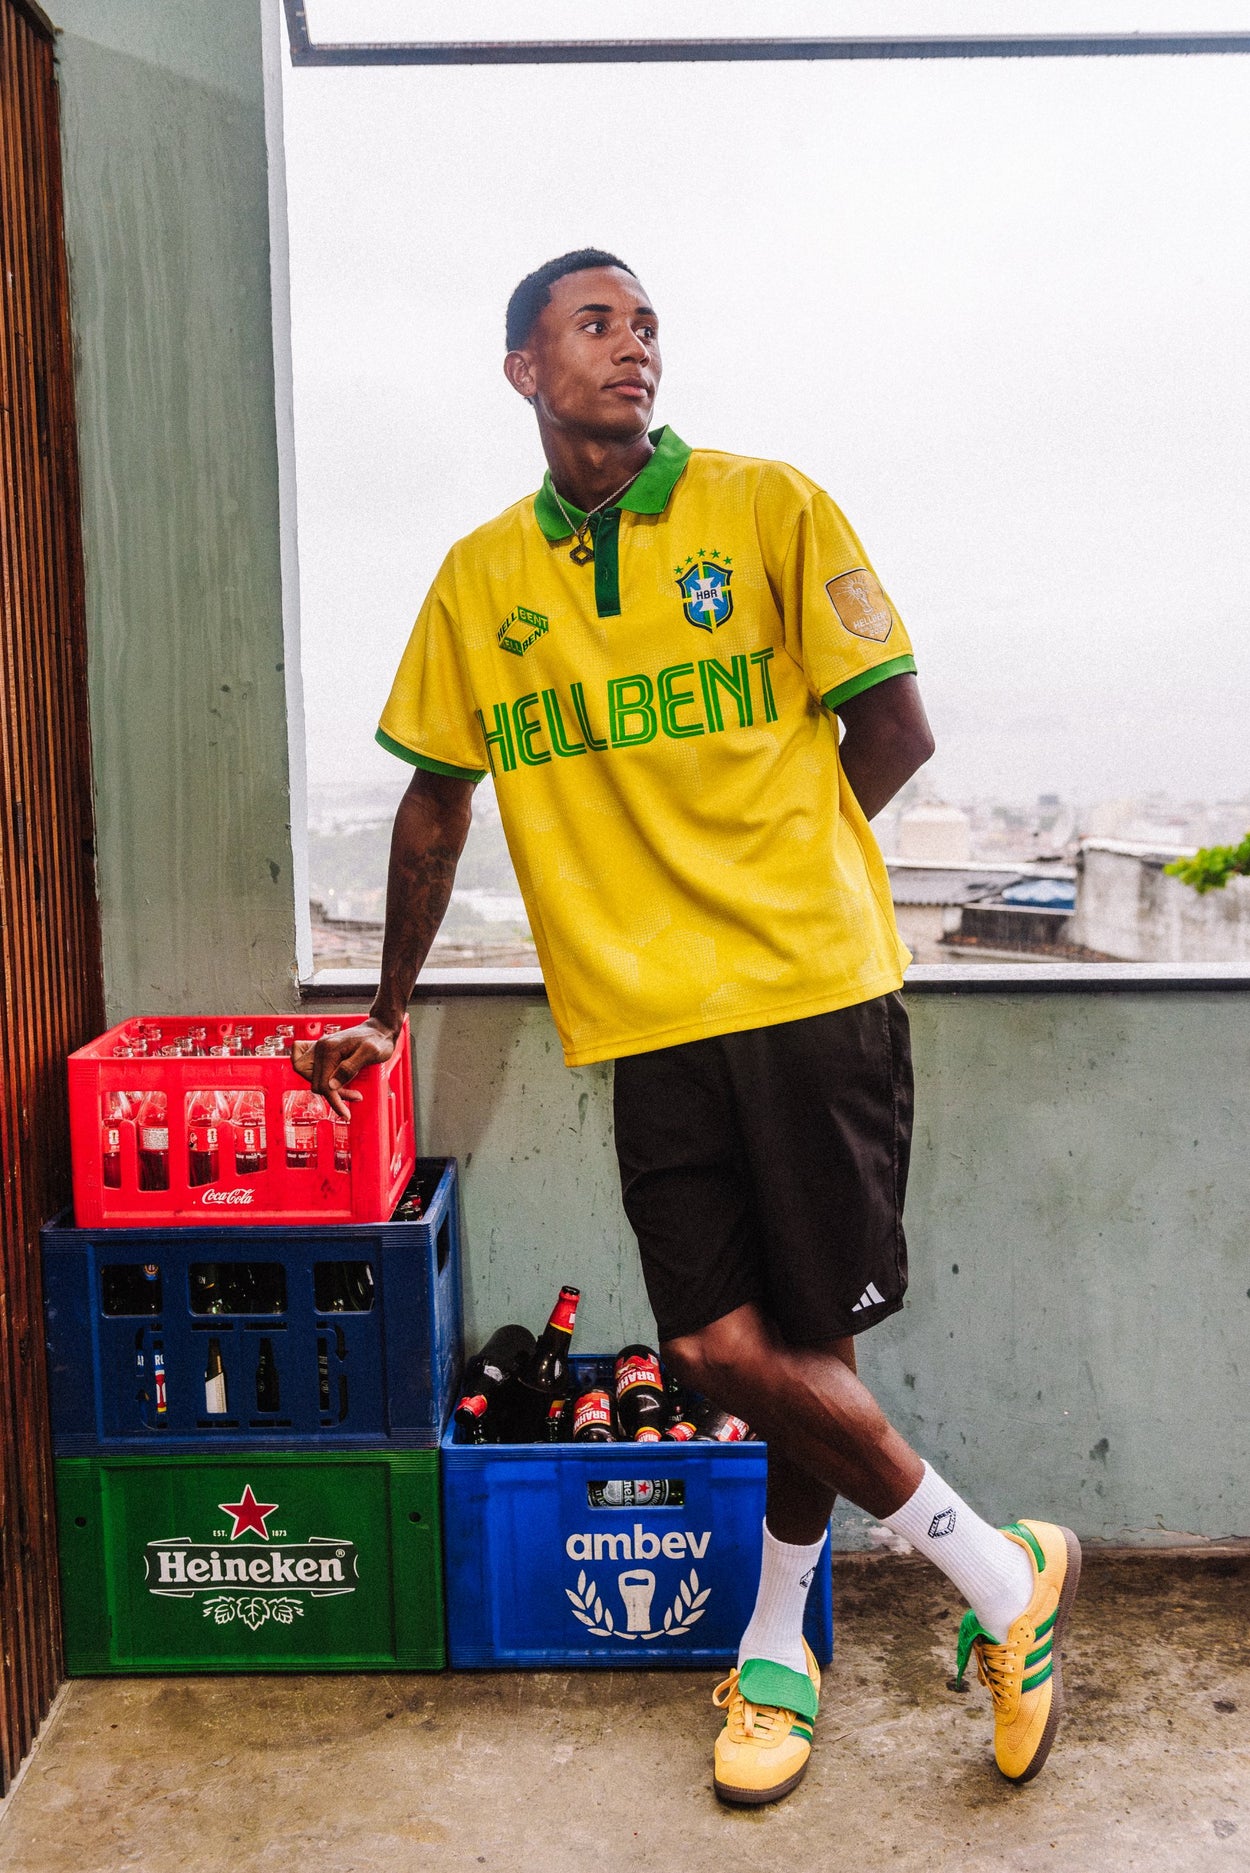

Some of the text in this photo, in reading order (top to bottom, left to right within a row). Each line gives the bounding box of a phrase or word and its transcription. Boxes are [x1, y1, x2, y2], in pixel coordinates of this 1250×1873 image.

[696, 589, 718, 600] HBR
[497, 612, 517, 641] HELL
[520, 609, 547, 629] BENT
[476, 647, 778, 777] HELLBENT
[202, 1189, 255, 1205] Coca-Cola
[566, 1523, 712, 1560] ambev
